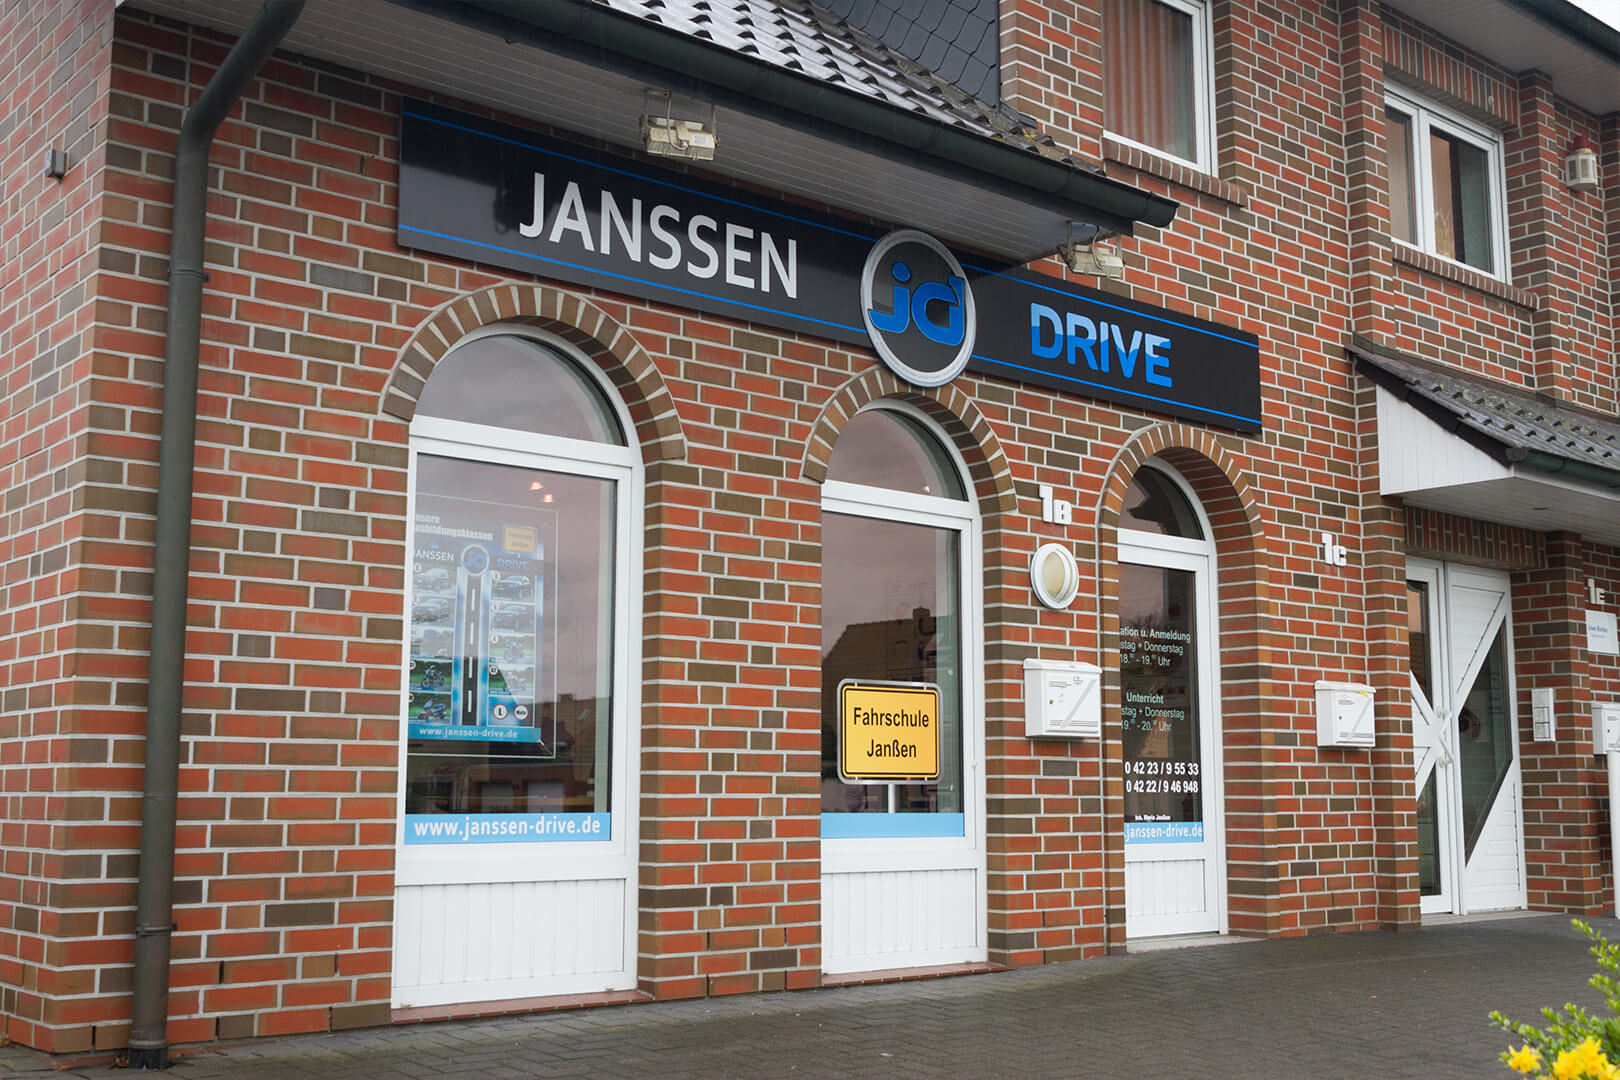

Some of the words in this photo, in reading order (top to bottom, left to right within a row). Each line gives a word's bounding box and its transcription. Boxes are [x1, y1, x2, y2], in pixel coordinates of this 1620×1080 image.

[519, 172, 797, 299] JANSSEN
[1030, 302, 1173, 388] DRIVE
[415, 549, 455, 562] ANSSEN
[497, 557, 529, 571] DRIVE
[1587, 578, 1605, 605] 1E
[1140, 629, 1149, 638] u.
[1149, 628, 1191, 644] Anmeldung
[1120, 640, 1136, 652] stag
[1144, 641, 1184, 656] Donnerstag
[1158, 656, 1171, 667] Uhr
[1126, 692, 1164, 704] Unterricht
[853, 707, 929, 727] Fahrschule
[1121, 706, 1137, 718] stag
[1145, 706, 1184, 720] Donnerstag
[419, 727, 518, 739] www.janssen-drive.de
[1159, 722, 1172, 732] Uhr
[867, 739, 917, 758] Janßen
[1124, 761, 1131, 774] 0
[1133, 761, 1145, 774] 42
[1147, 762, 1159, 774] 23
[1166, 762, 1172, 775] 9
[1174, 762, 1186, 775] 55
[1187, 763, 1199, 775] 33
[1126, 780, 1132, 793] 0
[1133, 780, 1145, 793] 42
[1146, 780, 1157, 793] 22
[1163, 780, 1169, 793] 9
[1170, 781, 1182, 793] 46
[1183, 781, 1199, 793] 948
[414, 816, 601, 841] www.janssen-drive.de
